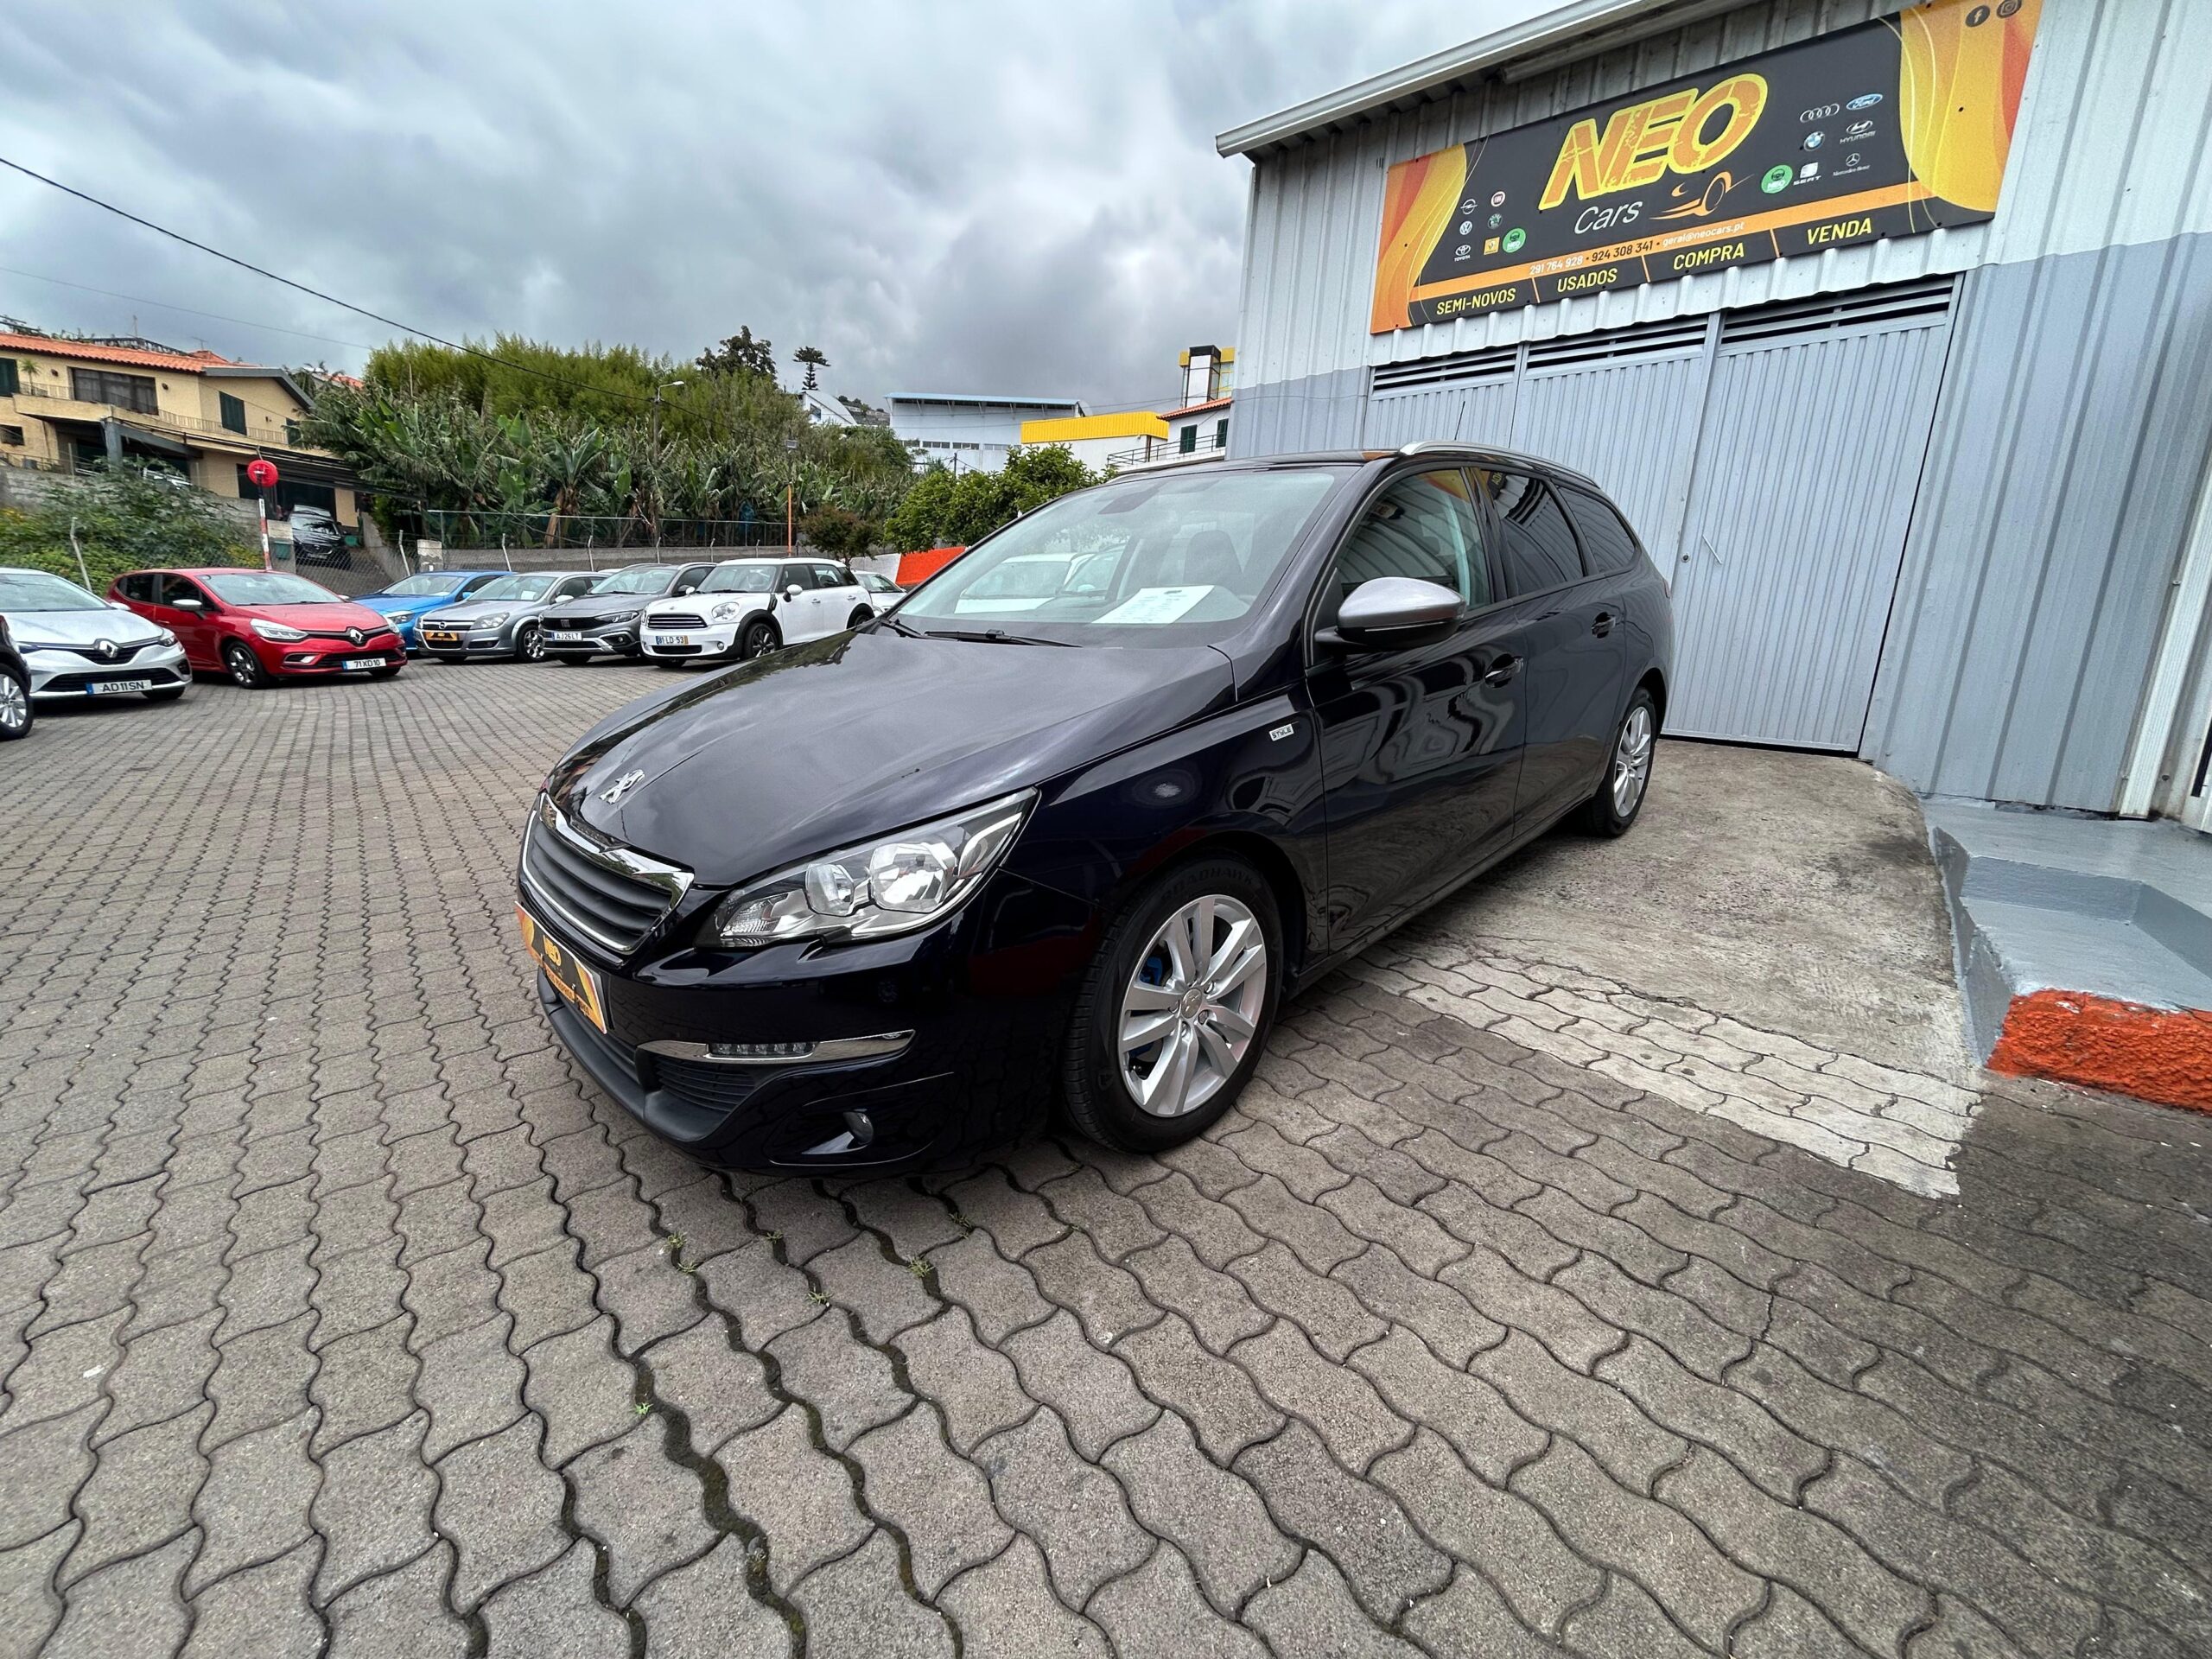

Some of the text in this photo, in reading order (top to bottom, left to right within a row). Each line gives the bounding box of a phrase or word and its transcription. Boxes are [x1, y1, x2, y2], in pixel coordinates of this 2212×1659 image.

[1538, 73, 1768, 210] NEO
[1793, 175, 1821, 186] SEAT
[1573, 201, 1643, 235] Cars
[1807, 218, 1873, 245] VENDA
[1529, 264, 1545, 275] 291
[1546, 260, 1563, 272] 764
[1565, 257, 1584, 269] 928
[1592, 250, 1611, 262] 924
[1613, 245, 1633, 258] 308
[1635, 240, 1654, 253] 341
[1673, 242, 1745, 270] COMPRA
[1557, 268, 1618, 293] USADOS
[1437, 288, 1516, 315] SEMI-NOVOS
